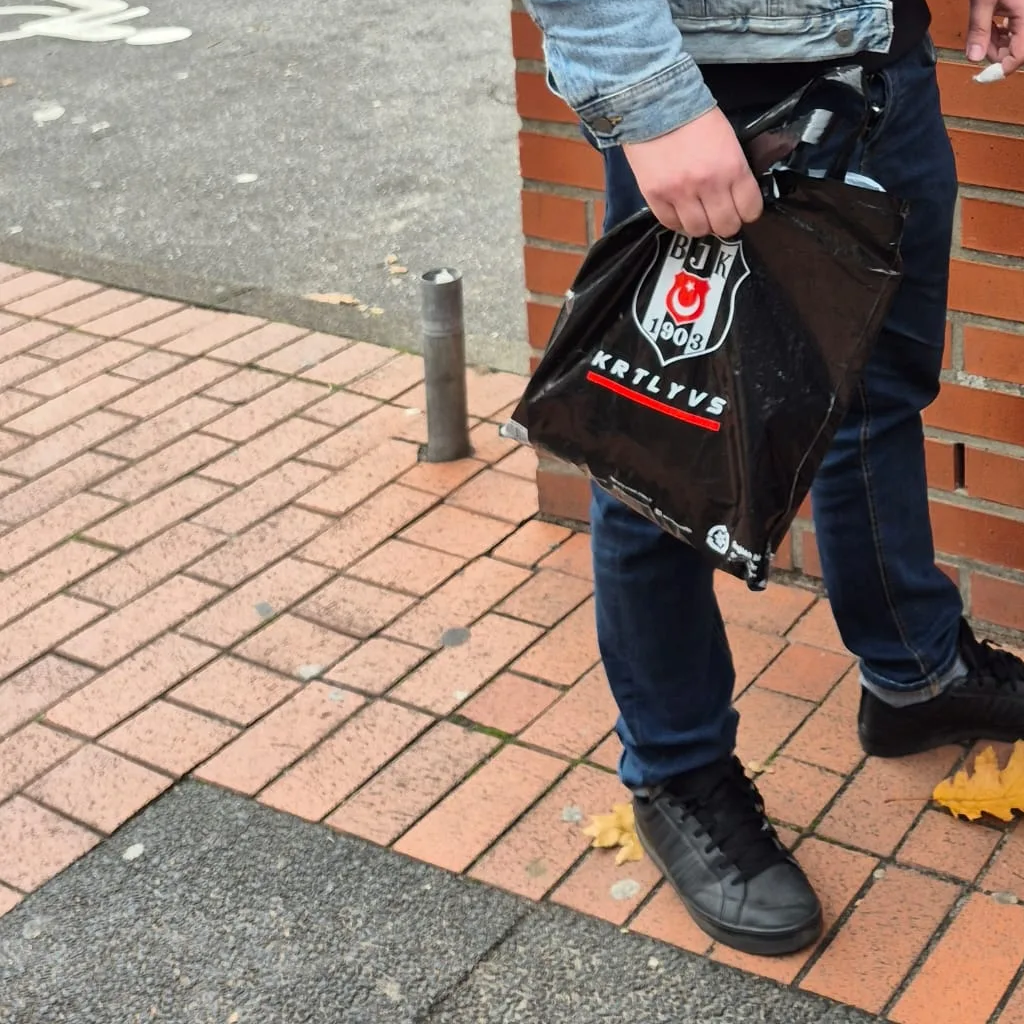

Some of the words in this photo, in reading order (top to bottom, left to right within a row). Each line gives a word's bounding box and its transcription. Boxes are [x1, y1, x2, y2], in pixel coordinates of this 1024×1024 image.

[671, 234, 733, 279] BJK
[648, 318, 704, 351] 1903
[591, 350, 727, 416] KRTLYVS
